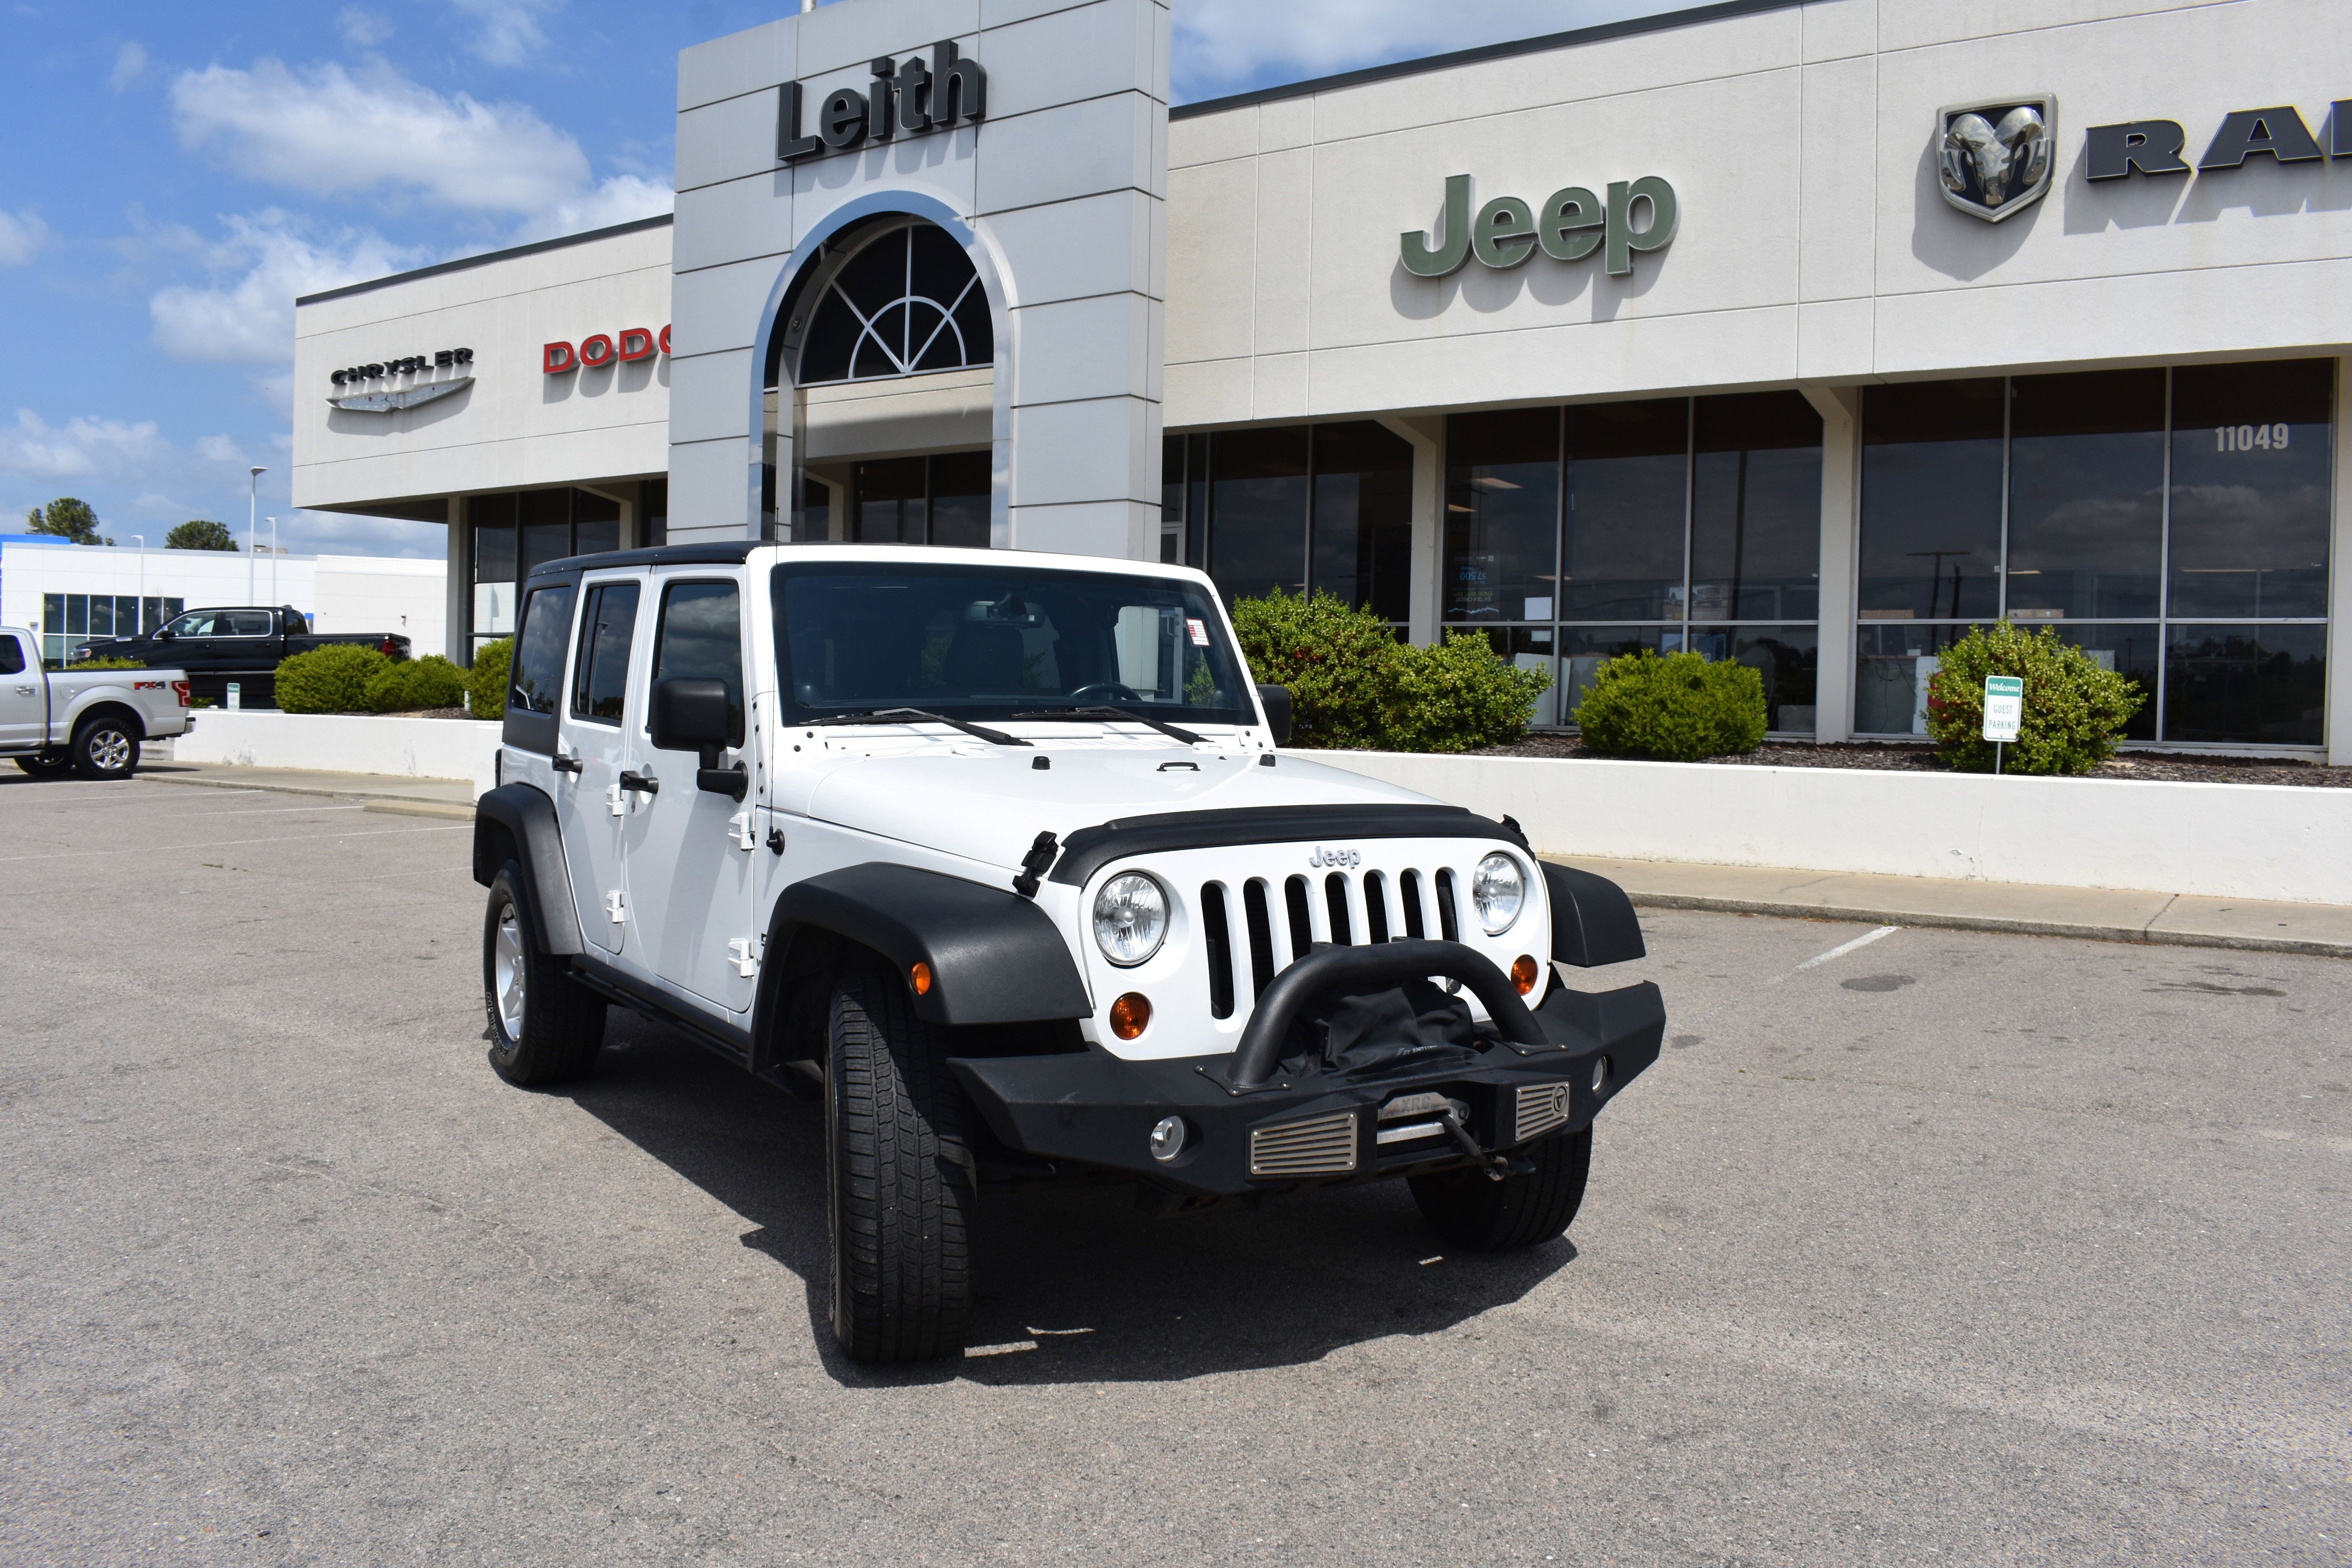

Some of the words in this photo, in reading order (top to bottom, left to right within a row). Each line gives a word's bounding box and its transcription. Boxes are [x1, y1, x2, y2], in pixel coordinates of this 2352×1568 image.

[776, 39, 987, 162] Leith
[2085, 98, 2352, 183] RA
[1401, 174, 1681, 277] Jeep
[331, 347, 474, 385] CHRYSLER
[2215, 423, 2289, 452] 11049
[134, 682, 166, 690] FX4
[1989, 683, 2020, 692] Welcome
[1993, 704, 2013, 714] GUEST
[1988, 720, 2016, 730] PARKING
[1308, 846, 1361, 869] Jeep
[1402, 1096, 1431, 1111] XRC
